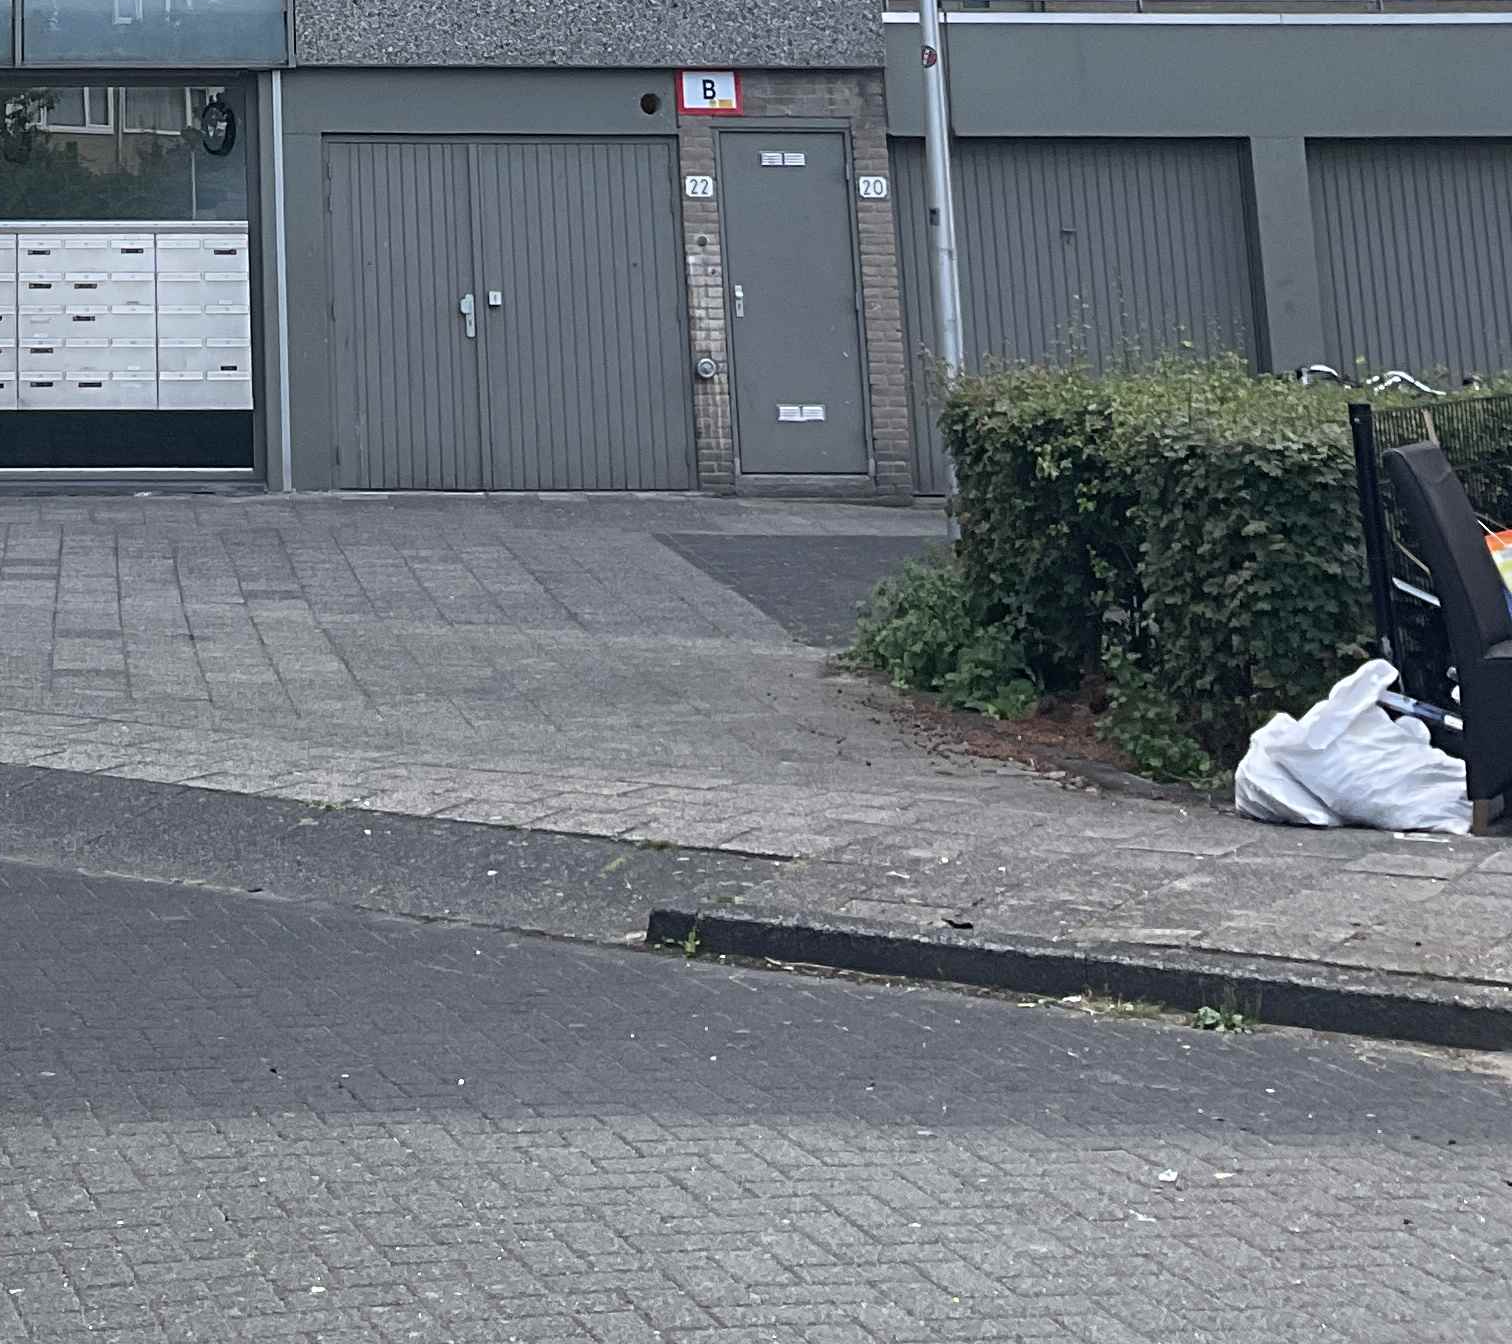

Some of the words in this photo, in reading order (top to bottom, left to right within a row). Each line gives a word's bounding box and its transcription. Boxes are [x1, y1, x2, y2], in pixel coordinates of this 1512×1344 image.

[701, 79, 717, 100] B
[690, 178, 709, 195] 22
[862, 179, 884, 196] 20
